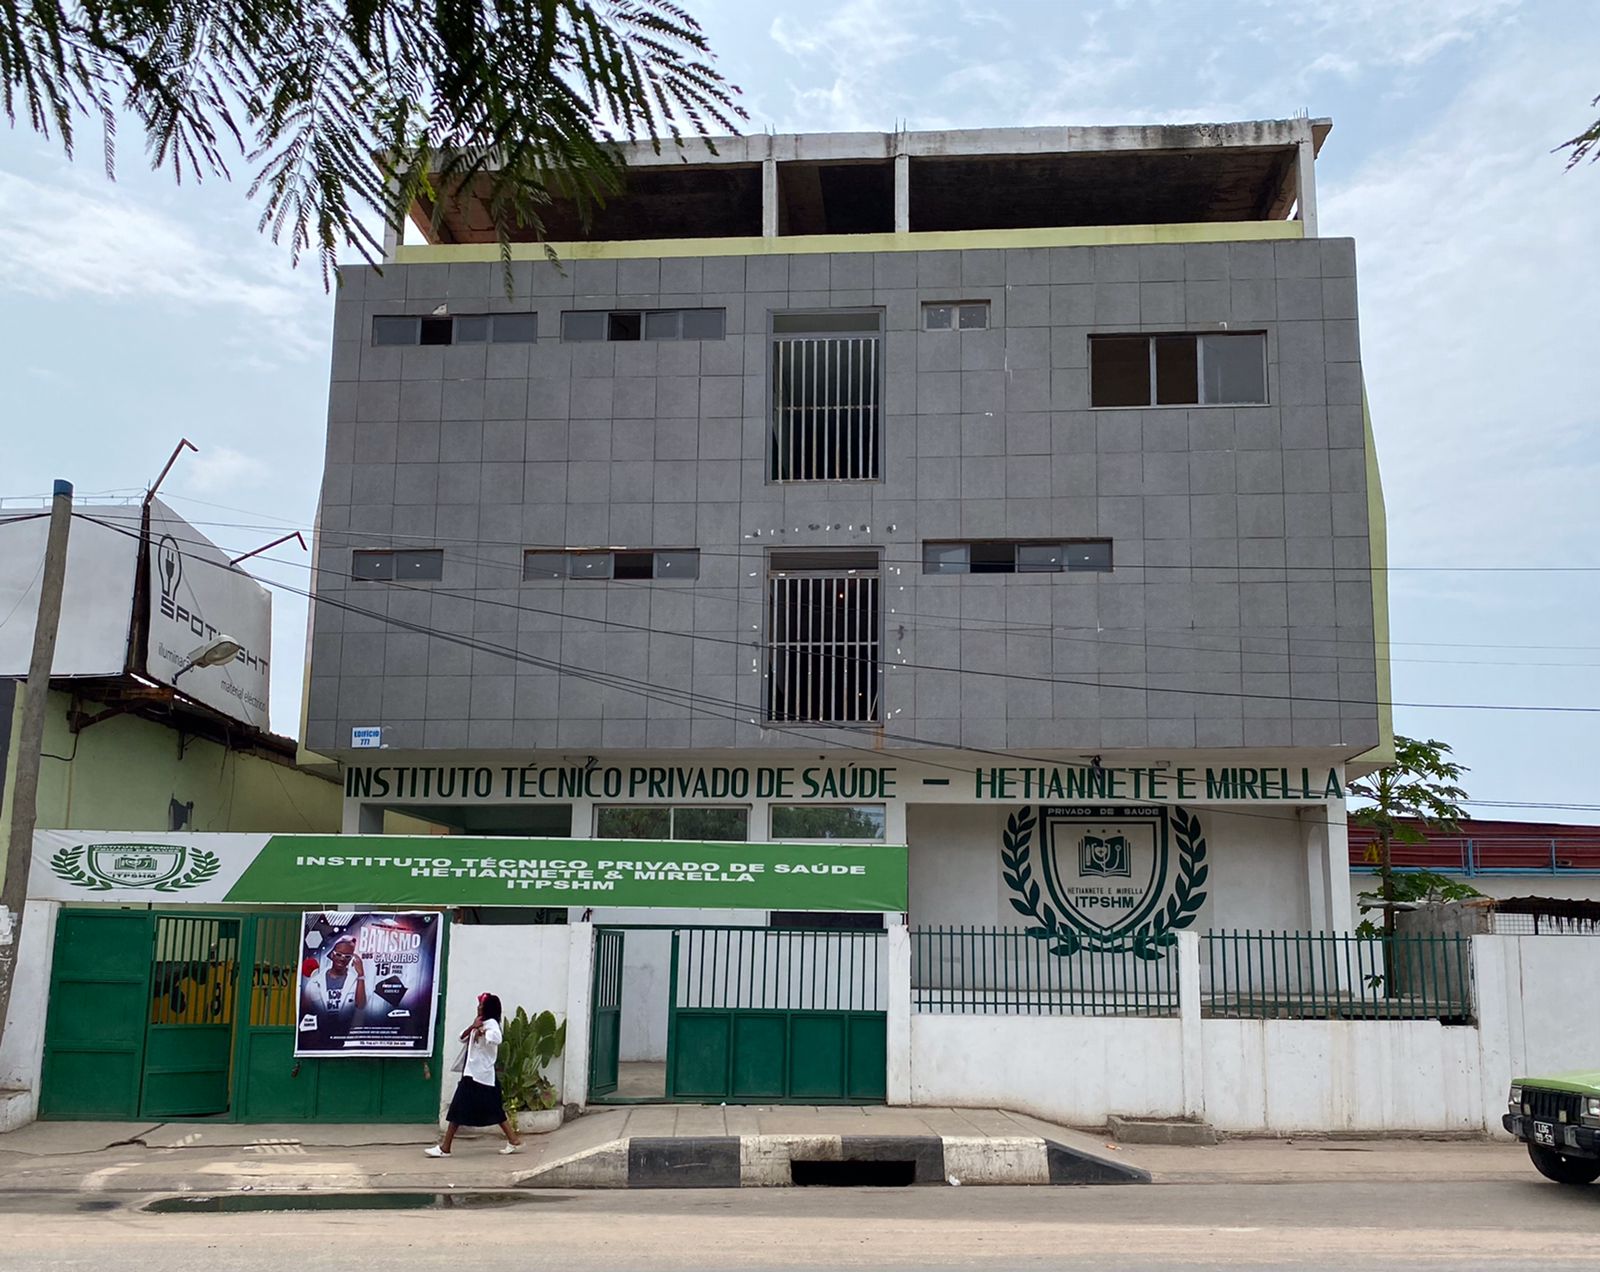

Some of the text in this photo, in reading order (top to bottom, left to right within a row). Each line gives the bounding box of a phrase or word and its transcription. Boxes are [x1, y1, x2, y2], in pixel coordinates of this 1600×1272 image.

[161, 595, 268, 675] SPOTGHT
[361, 738, 370, 746] 777
[346, 767, 493, 798] INSTITUTO
[501, 763, 622, 798] TÉCNICO
[629, 767, 750, 798] PRIVADO
[756, 767, 795, 798] DE
[801, 762, 897, 798] SAÚDE
[975, 767, 1168, 799] HETIANNETE
[1177, 767, 1197, 799] E
[1206, 768, 1343, 799] MIRELLA
[1047, 806, 1160, 816] PRIVADO DE SAÚDE
[296, 856, 867, 875] INSTITUTO TÉCNICO PRIVADO DE SAÚDE
[411, 867, 756, 883] HETIANNETE & MIRELLA
[507, 880, 615, 891] ITPSHM
[1116, 887, 1144, 895] MIRELLA
[1075, 896, 1135, 908] ITPSHM
[359, 926, 421, 953] BATISMO
[375, 963, 389, 976] 15
